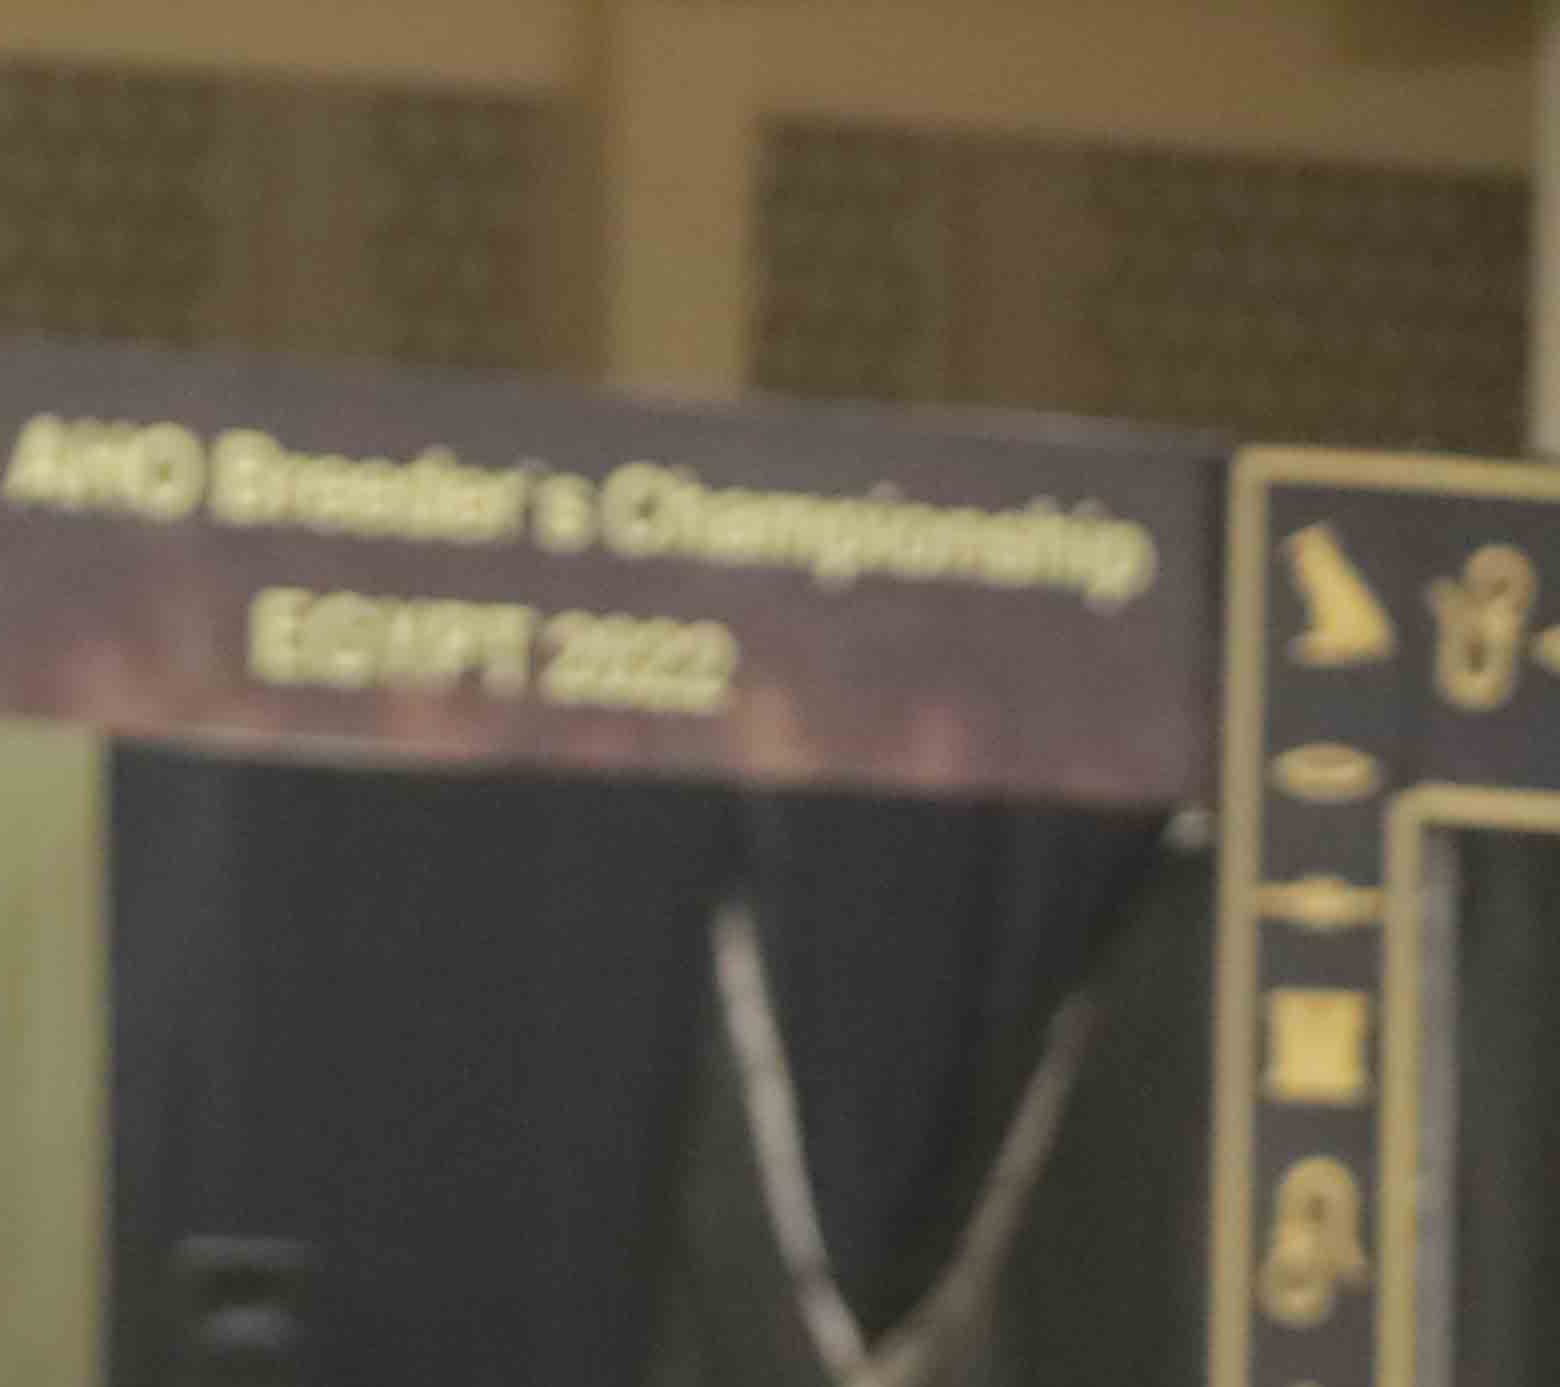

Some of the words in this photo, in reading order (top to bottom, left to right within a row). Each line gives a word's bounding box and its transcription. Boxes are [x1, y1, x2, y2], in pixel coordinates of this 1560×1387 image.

[601, 463, 1156, 613] Championship
[251, 586, 536, 692] EGYPT
[540, 610, 737, 714] 2022
